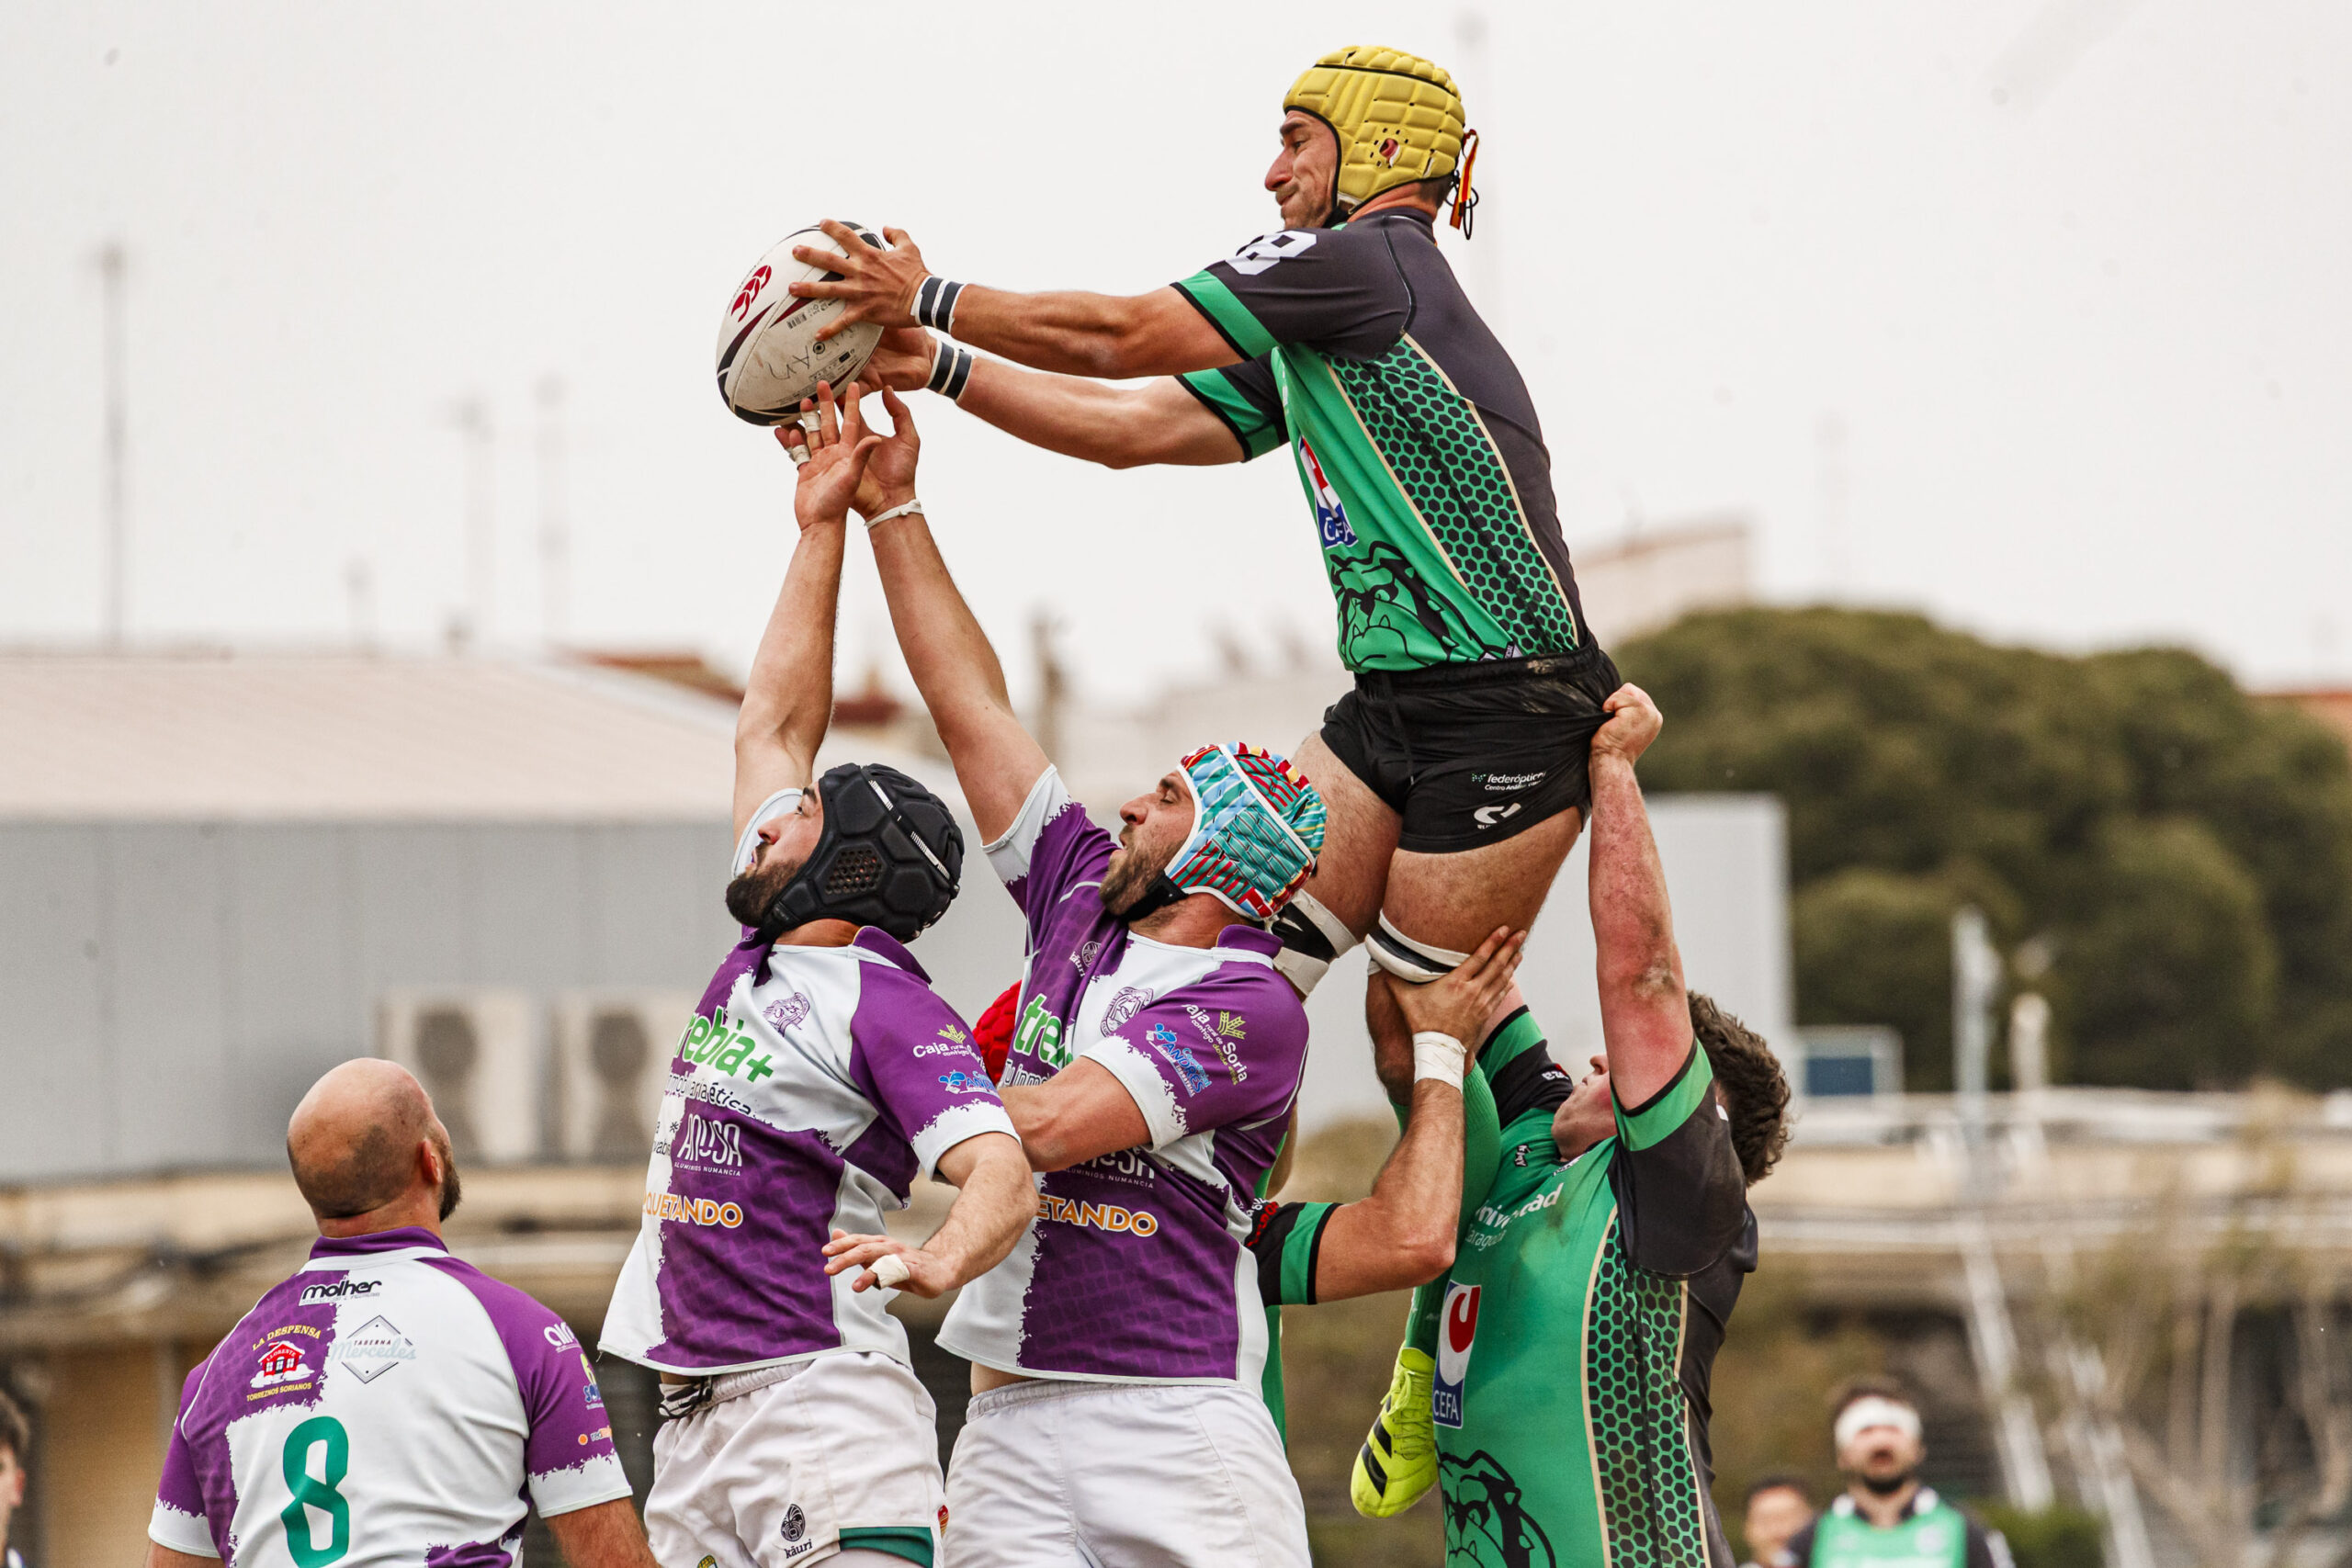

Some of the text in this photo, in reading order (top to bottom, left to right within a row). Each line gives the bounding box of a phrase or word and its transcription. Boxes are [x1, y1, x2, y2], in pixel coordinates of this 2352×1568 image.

[912, 1043, 950, 1058] Caja
[1222, 1042, 1248, 1082] Soria
[703, 1165, 741, 1178] NUMANCIA
[1108, 1175, 1154, 1190] NUMANCIA
[301, 1280, 382, 1301] molher
[252, 1324, 322, 1351] LA DESPENSA
[266, 1348, 297, 1361] LLORENTE
[331, 1337, 416, 1360] Mercedes
[279, 1382, 312, 1393] SORIANOS
[1433, 1389, 1460, 1421] CEFA
[280, 1416, 350, 1568] 8
